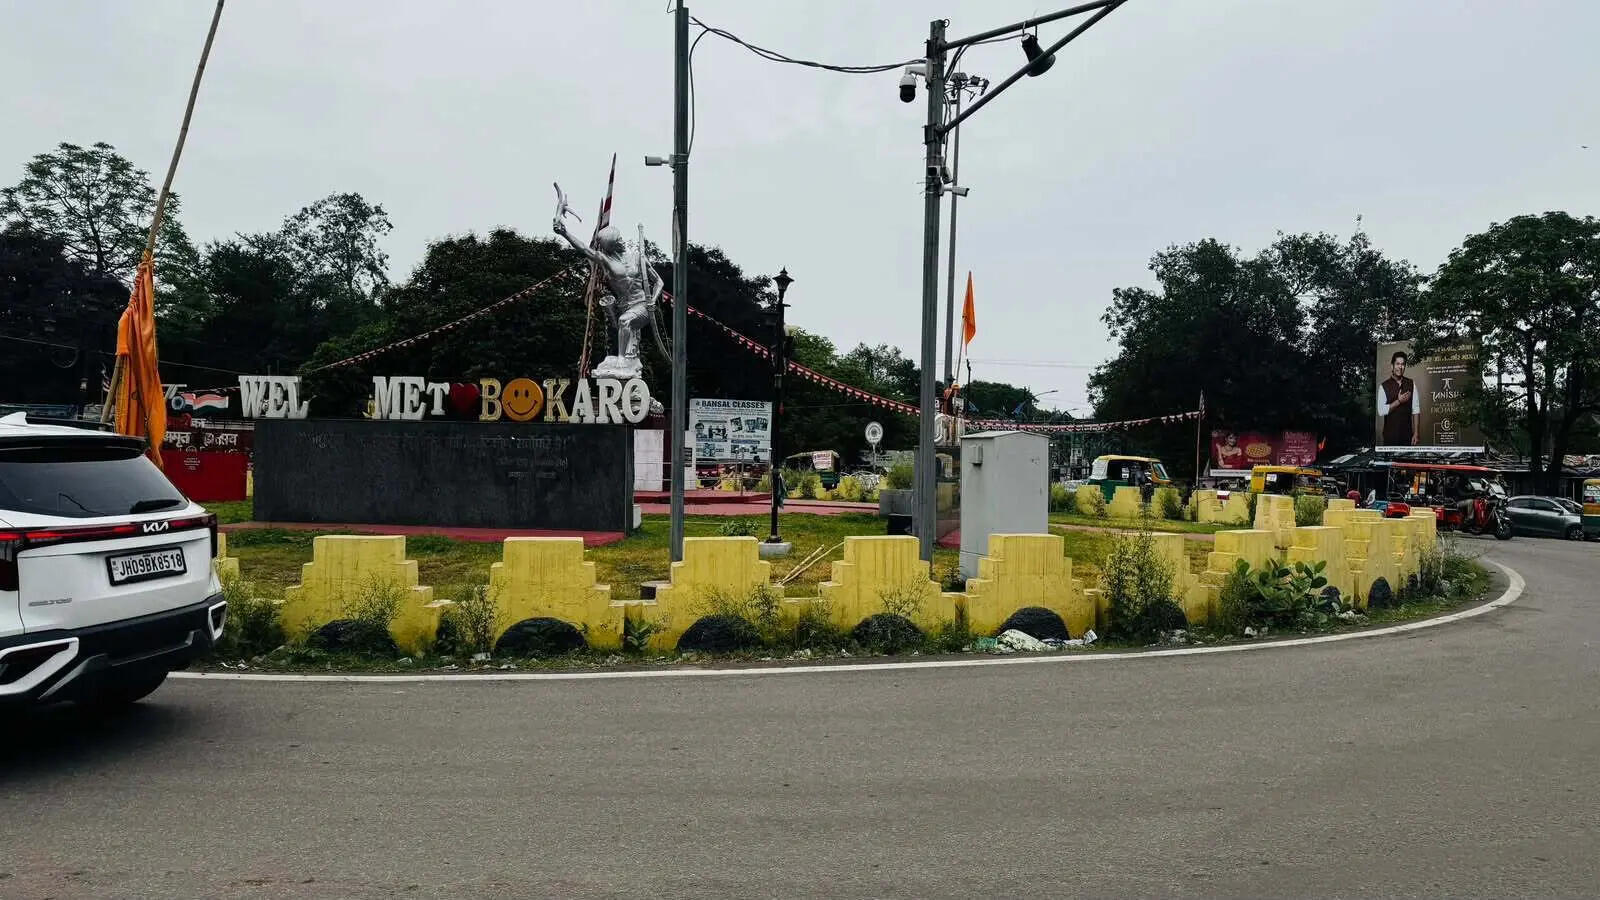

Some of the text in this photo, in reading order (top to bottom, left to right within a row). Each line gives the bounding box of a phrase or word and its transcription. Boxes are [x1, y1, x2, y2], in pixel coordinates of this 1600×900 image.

[238, 375, 309, 419] WEL
[702, 400, 765, 409] BANSAL CLASSES
[142, 521, 169, 533] KIA
[119, 553, 183, 576] JH09BK8518
